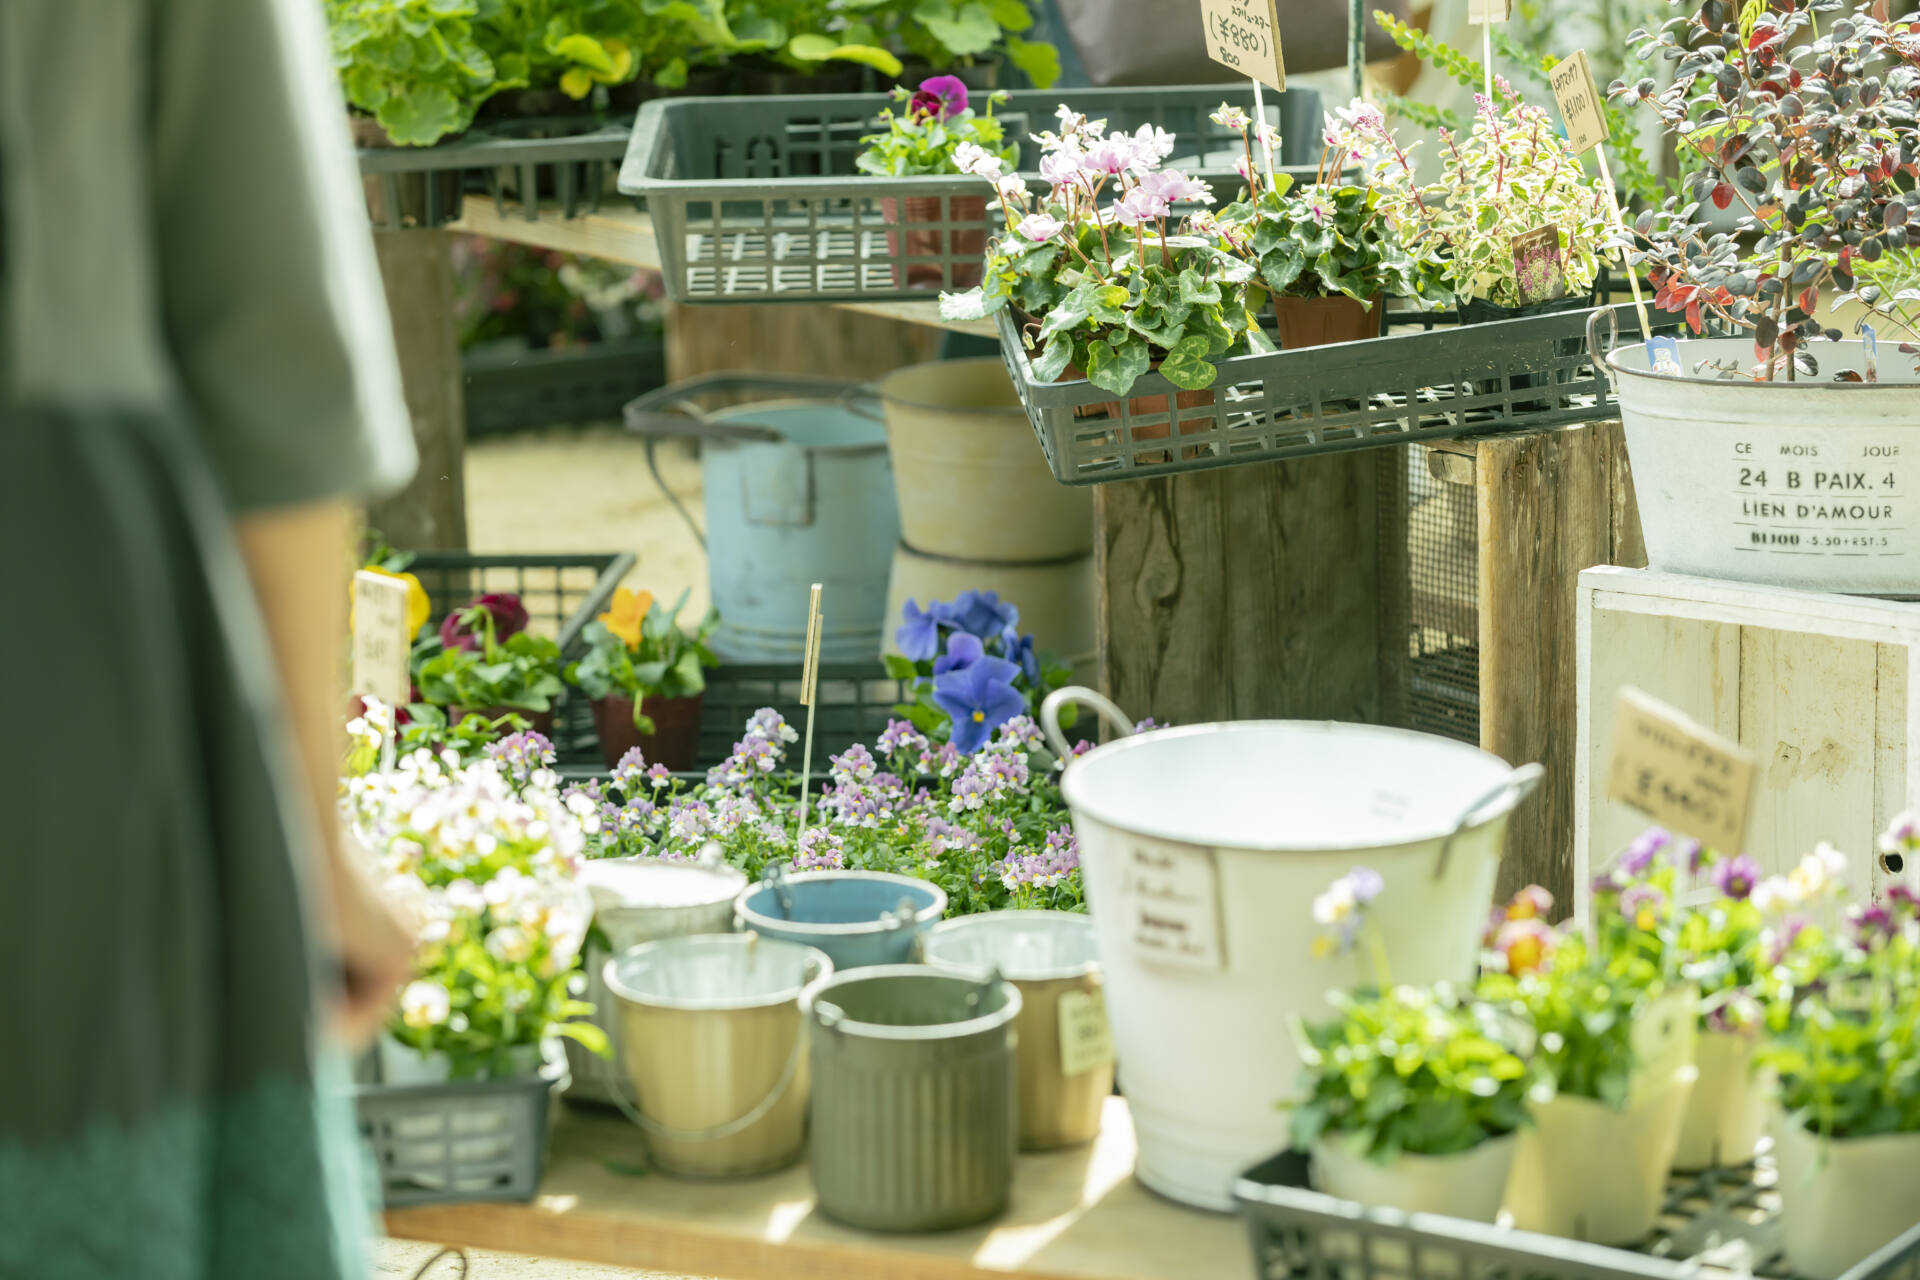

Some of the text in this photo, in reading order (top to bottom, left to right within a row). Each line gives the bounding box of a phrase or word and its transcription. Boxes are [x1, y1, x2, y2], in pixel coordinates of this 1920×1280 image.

[1735, 442, 1901, 457] CE MOIS JOUR
[1739, 468, 1895, 490] 24 B PAIX. 4
[1744, 499, 1893, 519] LIEN D'AMOUR
